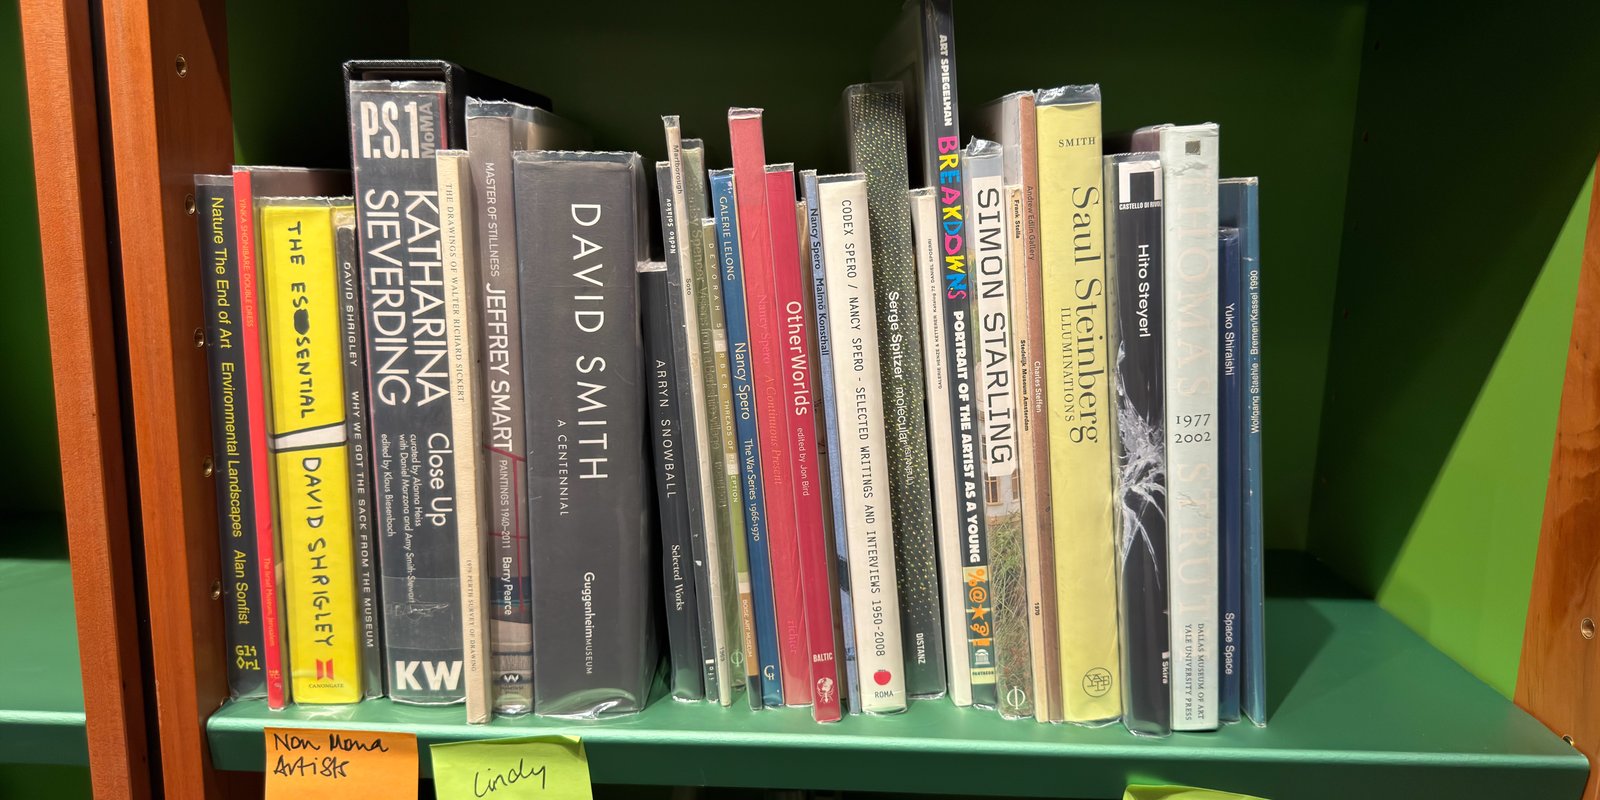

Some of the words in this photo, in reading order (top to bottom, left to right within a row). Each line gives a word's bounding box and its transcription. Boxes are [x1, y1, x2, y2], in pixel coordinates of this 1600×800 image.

[939, 35, 948, 56] ART
[941, 59, 953, 126] SPIEGELMAN
[419, 102, 435, 159] MoMA
[1059, 139, 1096, 147] SMITH
[485, 163, 496, 204] MASTER
[673, 145, 684, 195] Marlborough
[445, 184, 454, 203] THE
[1026, 186, 1034, 212] Andrew
[1119, 203, 1144, 211] CASTELLO
[211, 197, 225, 244] Nature
[487, 207, 498, 220] OF
[666, 198, 674, 227] Solakov
[719, 196, 730, 238] GALERIE
[810, 208, 821, 239] Nancy
[841, 200, 854, 236] CODEX
[937, 136, 966, 299] BREAKDOWNS
[1072, 186, 1102, 266] Saul
[288, 221, 305, 265] THE
[447, 206, 456, 258] DRAWINGS
[668, 231, 676, 254] Nedko
[977, 188, 1004, 298] SIMON
[1027, 236, 1037, 261] Gallery
[214, 248, 227, 278] The
[488, 222, 499, 277] STILLNESS
[724, 241, 736, 281] LELONG
[811, 241, 823, 270] Spero
[845, 243, 857, 279] SPERO
[1138, 245, 1150, 279] Hito
[343, 262, 353, 300] DAVID
[450, 261, 458, 274] OF
[571, 203, 605, 333] DAVID
[1249, 270, 1259, 289] 1990
[217, 279, 229, 306] End
[364, 188, 411, 406] SIEVERDING
[404, 190, 450, 407] KATHARINA
[451, 277, 459, 316] WALTER
[815, 278, 827, 310] Malmö
[218, 310, 231, 324] of
[848, 297, 860, 331] NANCY
[888, 291, 903, 330] Serge
[1135, 282, 1151, 338] Steyerl
[1225, 303, 1235, 329] Yuko
[1249, 293, 1260, 355] Bremen/Kassel
[220, 328, 232, 349] Art
[345, 305, 358, 367] SHRIGLEY
[453, 319, 462, 361] RICHARD
[485, 283, 509, 374] JEFFREY
[708, 243, 720, 311] DEVORAH
[724, 400, 732, 436] THREADS
[818, 313, 830, 356] Konsthall
[954, 310, 968, 380] PORTRAIT
[291, 282, 315, 419] ESSENTIAL
[734, 342, 748, 380] Nancy
[786, 301, 810, 416] OtherWorlds
[851, 338, 863, 372] SPERO
[890, 334, 905, 380] Spitzer
[1060, 307, 1074, 422] ILLUMINATIONS
[1070, 278, 1104, 443] Steinberg
[1224, 332, 1235, 375] Shiraishi
[455, 363, 465, 402] SICKERT
[656, 360, 669, 407] ARRYN
[983, 312, 1012, 464] STARLING
[1034, 361, 1042, 386] Charles
[1250, 363, 1260, 394] Staehle
[221, 362, 240, 455] Environmental
[351, 391, 360, 417] WHY
[737, 384, 751, 420] Spero
[958, 383, 969, 401] OF
[1035, 388, 1043, 412] Steffen
[490, 380, 513, 452] SMART
[575, 356, 608, 479] SMITH
[856, 387, 869, 440] SELECTED
[960, 407, 971, 431] THE
[1175, 414, 1211, 428] 1977
[1249, 395, 1260, 433] Wolfgang
[353, 422, 361, 441] WE
[381, 434, 391, 457] edited
[743, 438, 754, 455] The
[796, 428, 806, 448] edited
[1175, 434, 1211, 444] 2002
[354, 444, 363, 467] GOT
[400, 450, 410, 476] Daniel
[409, 434, 419, 464] curated
[427, 432, 451, 490] Close
[661, 419, 677, 498] SNOWBALL
[745, 456, 756, 476] War
[961, 434, 974, 478] ARTIST
[356, 471, 365, 494] THE
[384, 472, 393, 492] Klaus
[499, 460, 509, 505] PAINTINGS
[558, 435, 569, 516] CENTENNIAL
[799, 465, 808, 478] Jon
[801, 480, 810, 496] Bird
[860, 446, 873, 498] WRITINGS
[228, 460, 243, 537] Landscapes
[302, 457, 325, 528] DAVID
[402, 479, 411, 514] Marzona
[412, 477, 422, 504] Alanna
[746, 478, 758, 500] Series
[965, 481, 975, 500] AS
[358, 499, 367, 531] SACK
[385, 494, 396, 537] Biesenbach
[414, 506, 423, 527] Heiss
[428, 496, 453, 527] Up
[750, 502, 760, 541] 1966-1970
[865, 505, 876, 524] AND
[966, 501, 976, 512] A
[360, 535, 369, 568] FROM
[968, 515, 980, 563] YOUNG
[234, 550, 246, 578] Alan
[501, 557, 512, 582] Barry
[671, 544, 682, 580] Selected
[866, 531, 881, 593] INTERVIEWS
[308, 538, 335, 646] SHRIGLEY
[362, 572, 371, 593] THE
[503, 584, 513, 615] Pearce
[674, 584, 684, 611] Works
[236, 582, 249, 624] Sonfist
[364, 598, 374, 648] MUSEUM
[871, 600, 885, 656] 1950-2008
[1197, 623, 1205, 651] DALLAS
[1223, 613, 1235, 643] Space
[813, 652, 833, 662] BALTIC
[915, 633, 926, 664] DISTANZ
[1223, 645, 1235, 674] Space
[396, 661, 463, 691] KW
[1197, 654, 1205, 689] MUSEUM
[274, 733, 320, 751] Non
[273, 755, 350, 779] Artists
